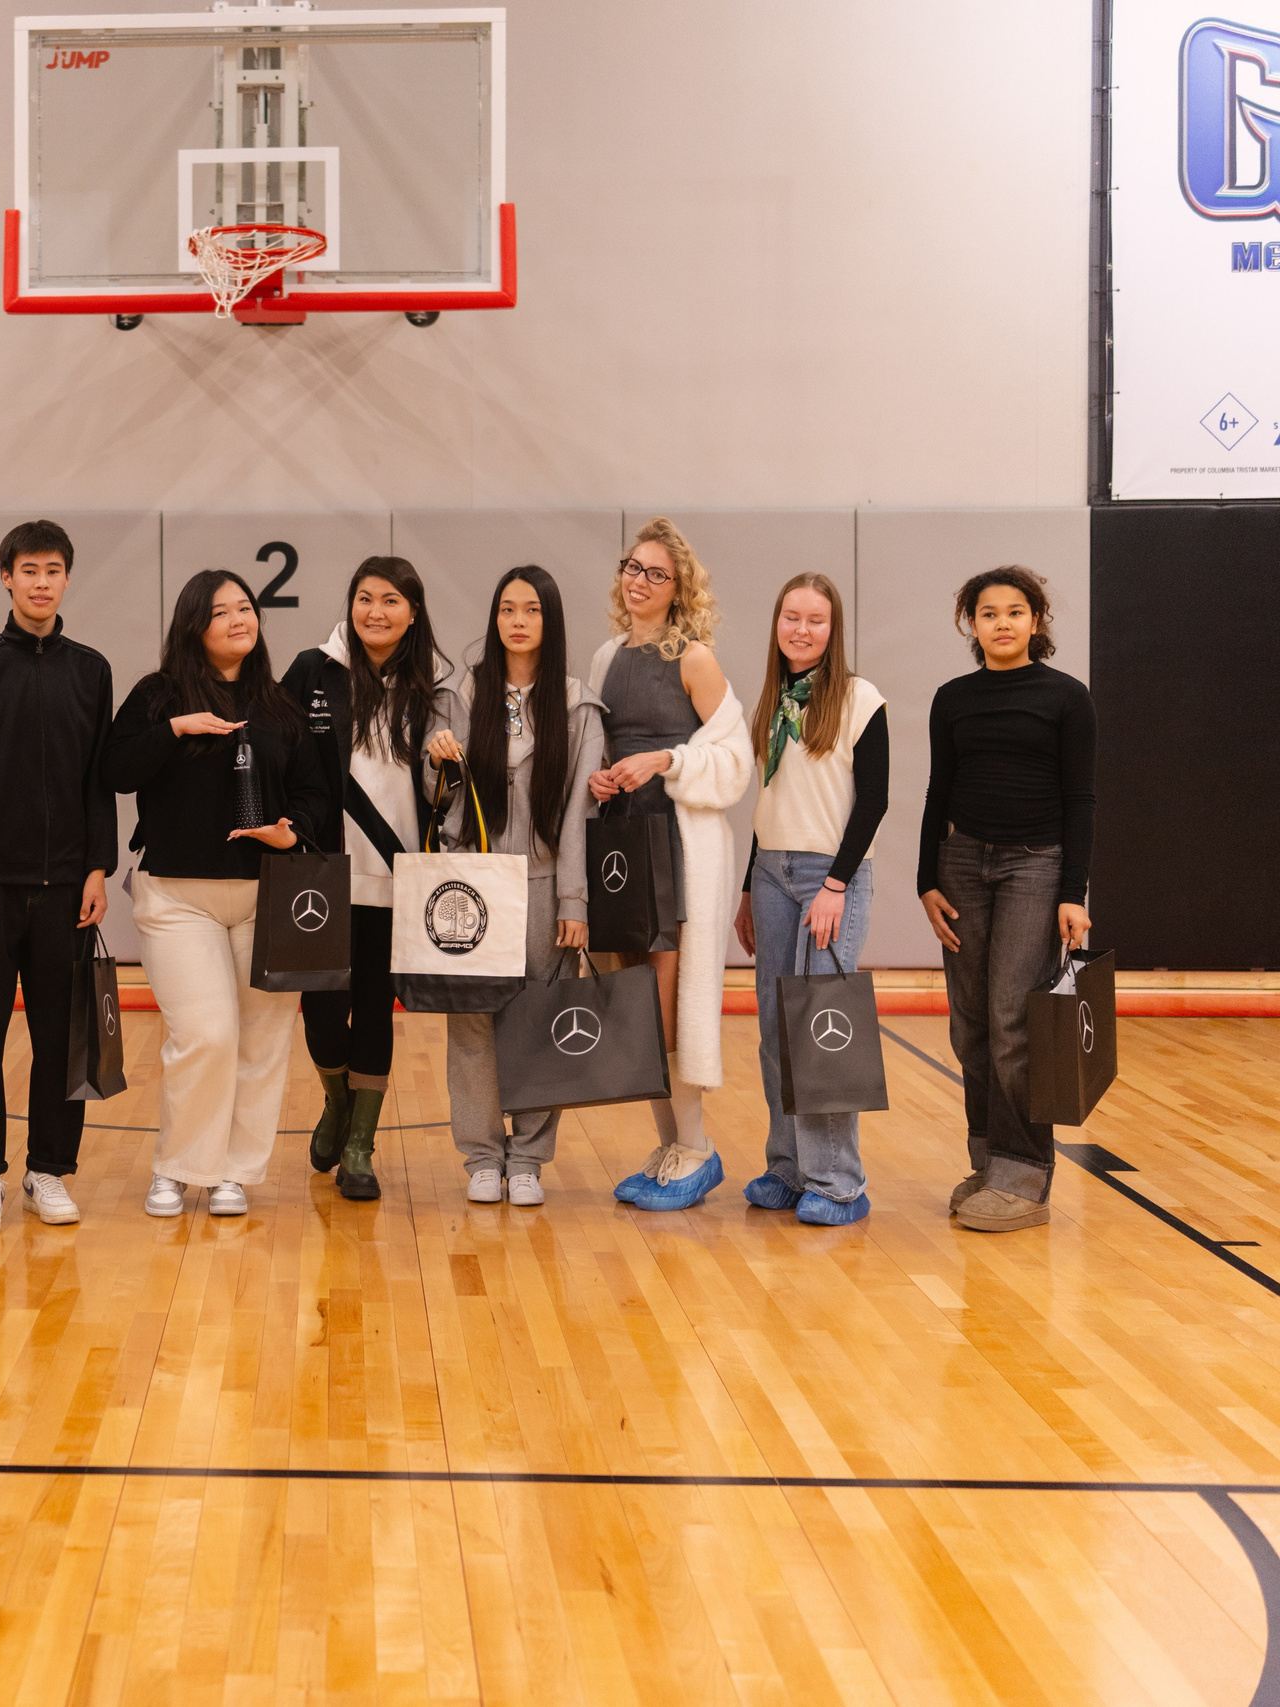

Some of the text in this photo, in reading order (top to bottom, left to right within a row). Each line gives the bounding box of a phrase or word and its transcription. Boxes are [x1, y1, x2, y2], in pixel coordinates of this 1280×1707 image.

[1219, 412, 1239, 431] 6+
[255, 541, 299, 608] 2
[435, 883, 476, 897] AFFALTERBACH
